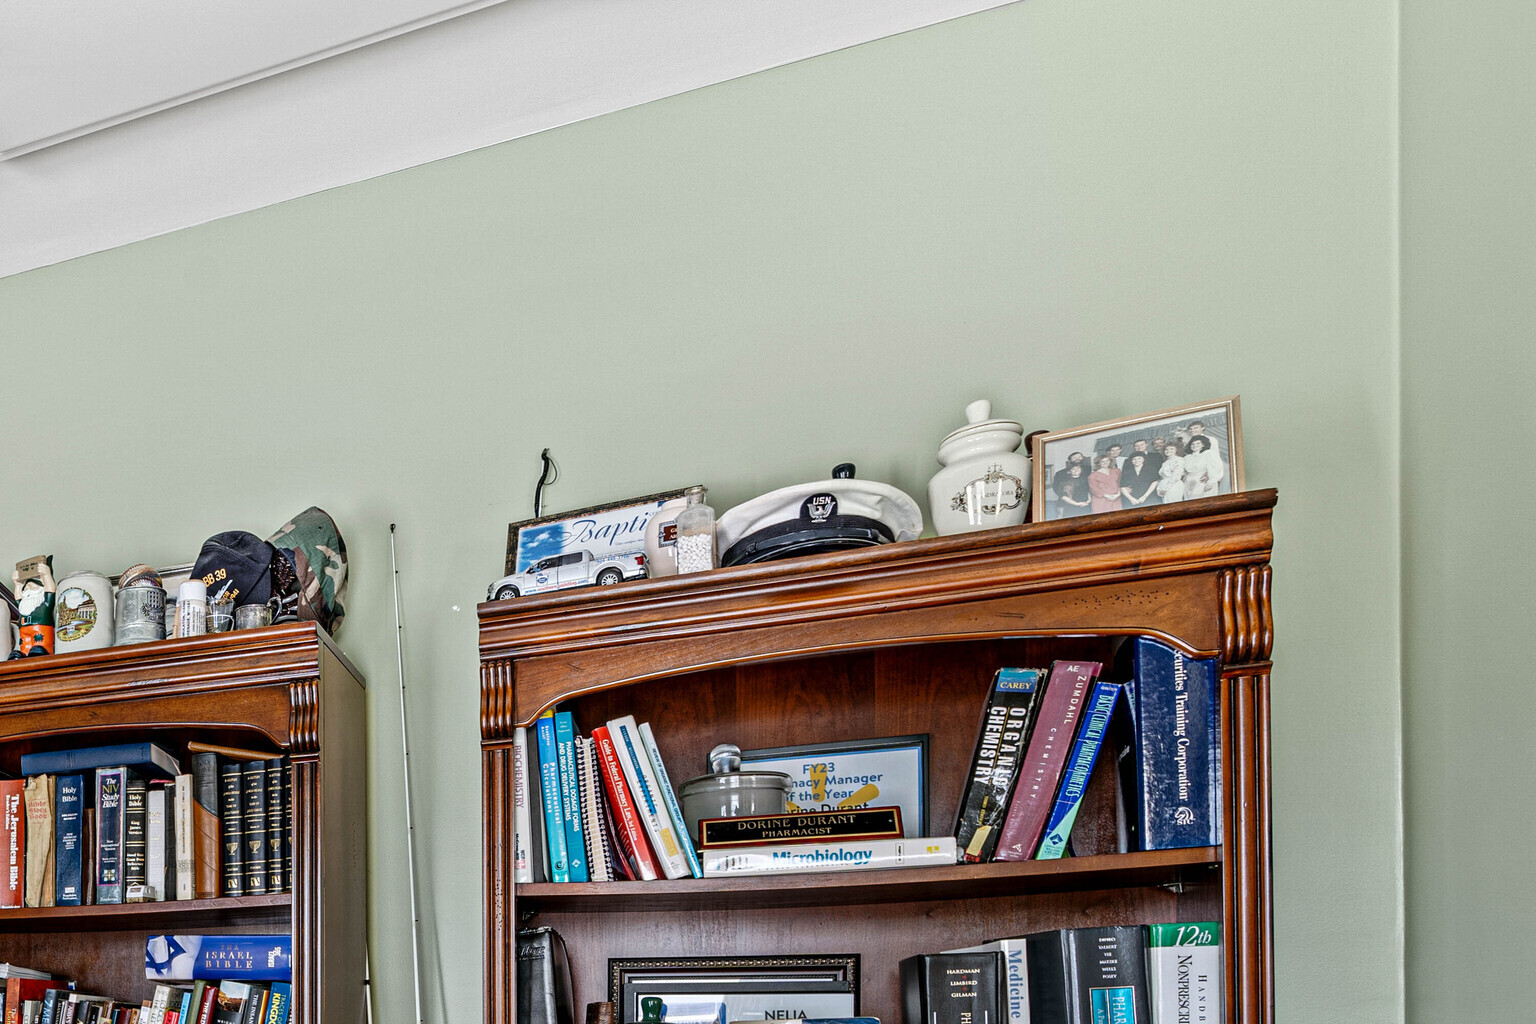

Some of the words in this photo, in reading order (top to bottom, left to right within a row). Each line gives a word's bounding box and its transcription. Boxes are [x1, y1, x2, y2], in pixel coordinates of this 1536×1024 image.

[812, 496, 832, 506] USN
[562, 512, 648, 547] Bapti
[202, 576, 215, 587] BB
[214, 568, 227, 581] 39
[1000, 681, 1032, 690] CAREY
[1064, 675, 1087, 724] ZUMDAHL
[974, 705, 1007, 786] CHEMISTRY
[802, 762, 835, 774] FY23
[1030, 727, 1057, 799] CHEMISTRY
[515, 745, 524, 808] BIOCHEMISTRY
[791, 778, 821, 790] macy
[824, 773, 883, 787] Manager
[102, 784, 120, 793] NIV
[796, 790, 820, 802] the
[823, 789, 854, 800] Year
[11, 794, 19, 809] The
[738, 818, 791, 831] DORINE
[797, 814, 856, 827] DURANT
[10, 811, 19, 865] Jerusalem
[762, 827, 832, 838] PHARMACIST
[772, 848, 872, 866] Microbiology
[9, 866, 19, 890] Bible
[1172, 926, 1212, 947] 12th
[206, 960, 253, 969] BIBLE
[1008, 950, 1022, 1020] Medicine
